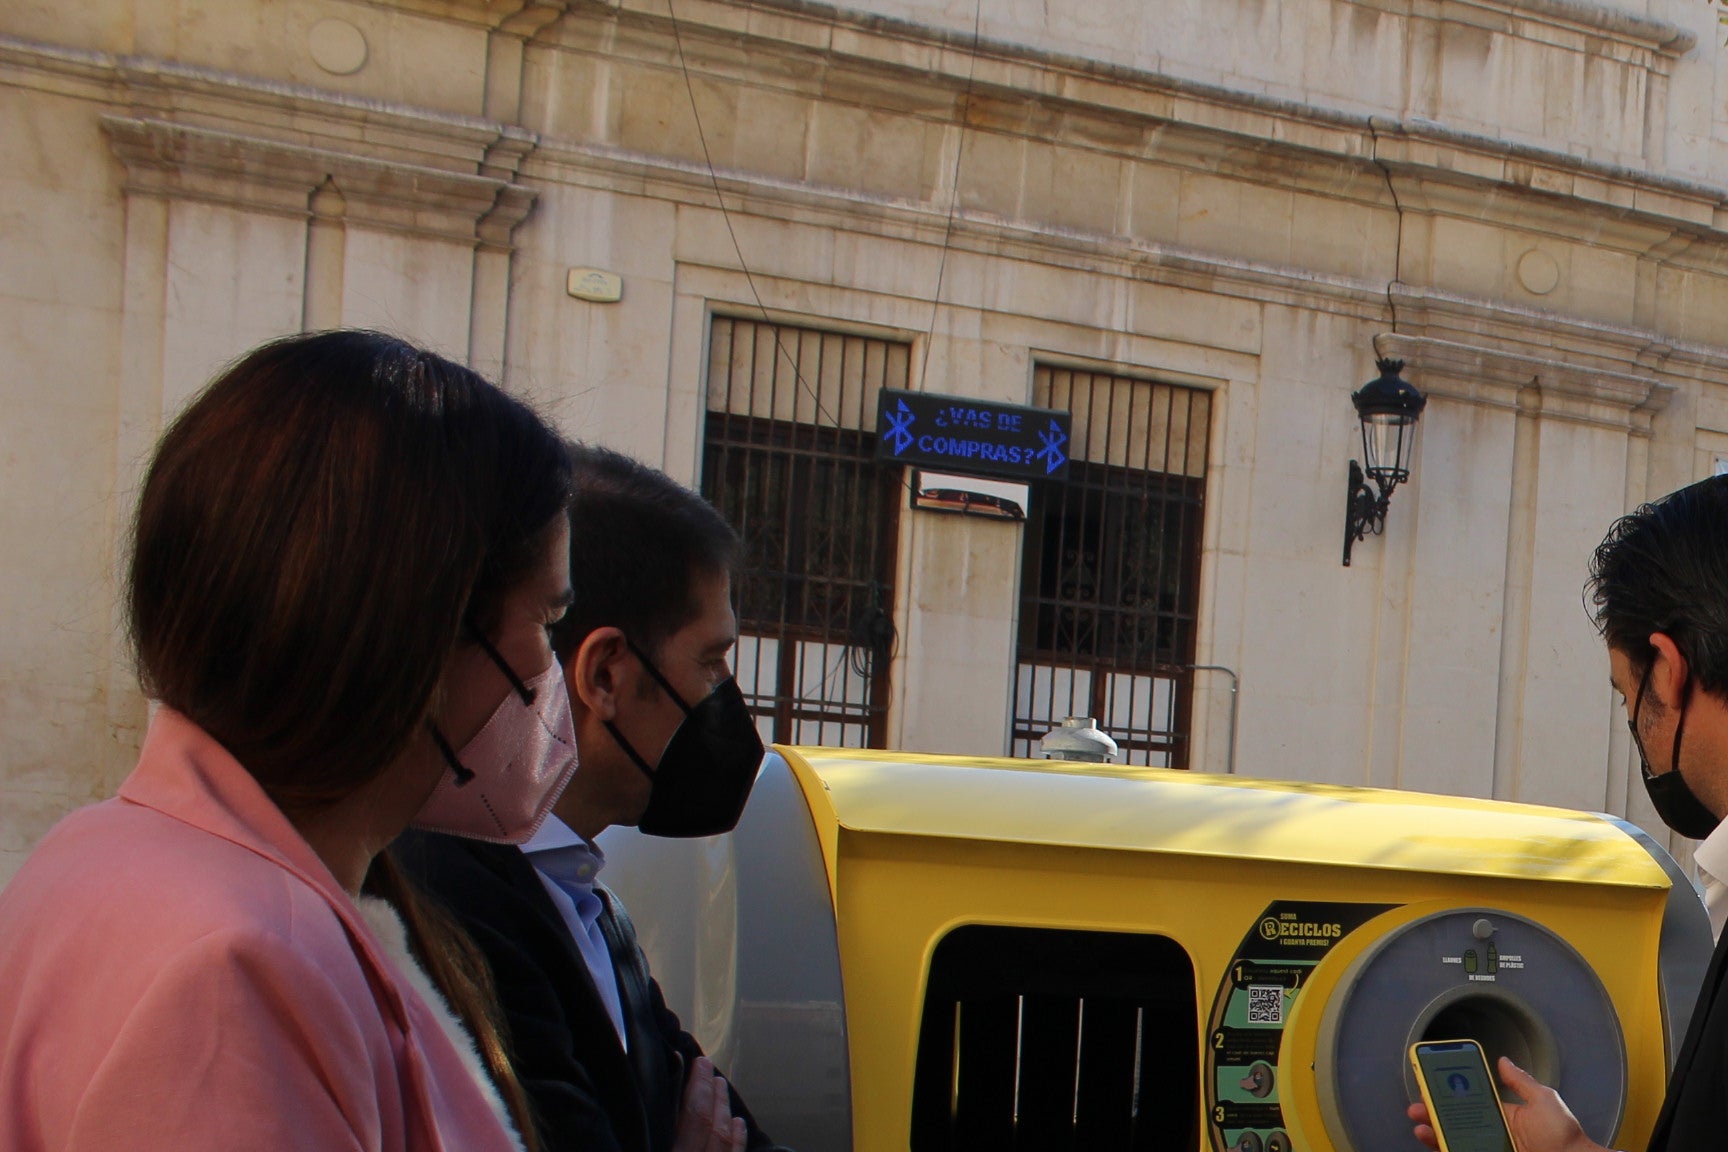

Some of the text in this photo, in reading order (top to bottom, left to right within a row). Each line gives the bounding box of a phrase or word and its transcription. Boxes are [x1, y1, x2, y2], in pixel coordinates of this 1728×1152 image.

[935, 407, 1022, 432] ¿VAS DE
[919, 435, 1034, 465] COMPRAS?
[1260, 918, 1341, 939] RECICLOS
[1235, 966, 1242, 982] 1
[1215, 1033, 1224, 1048] 2
[1215, 1106, 1225, 1122] 3
